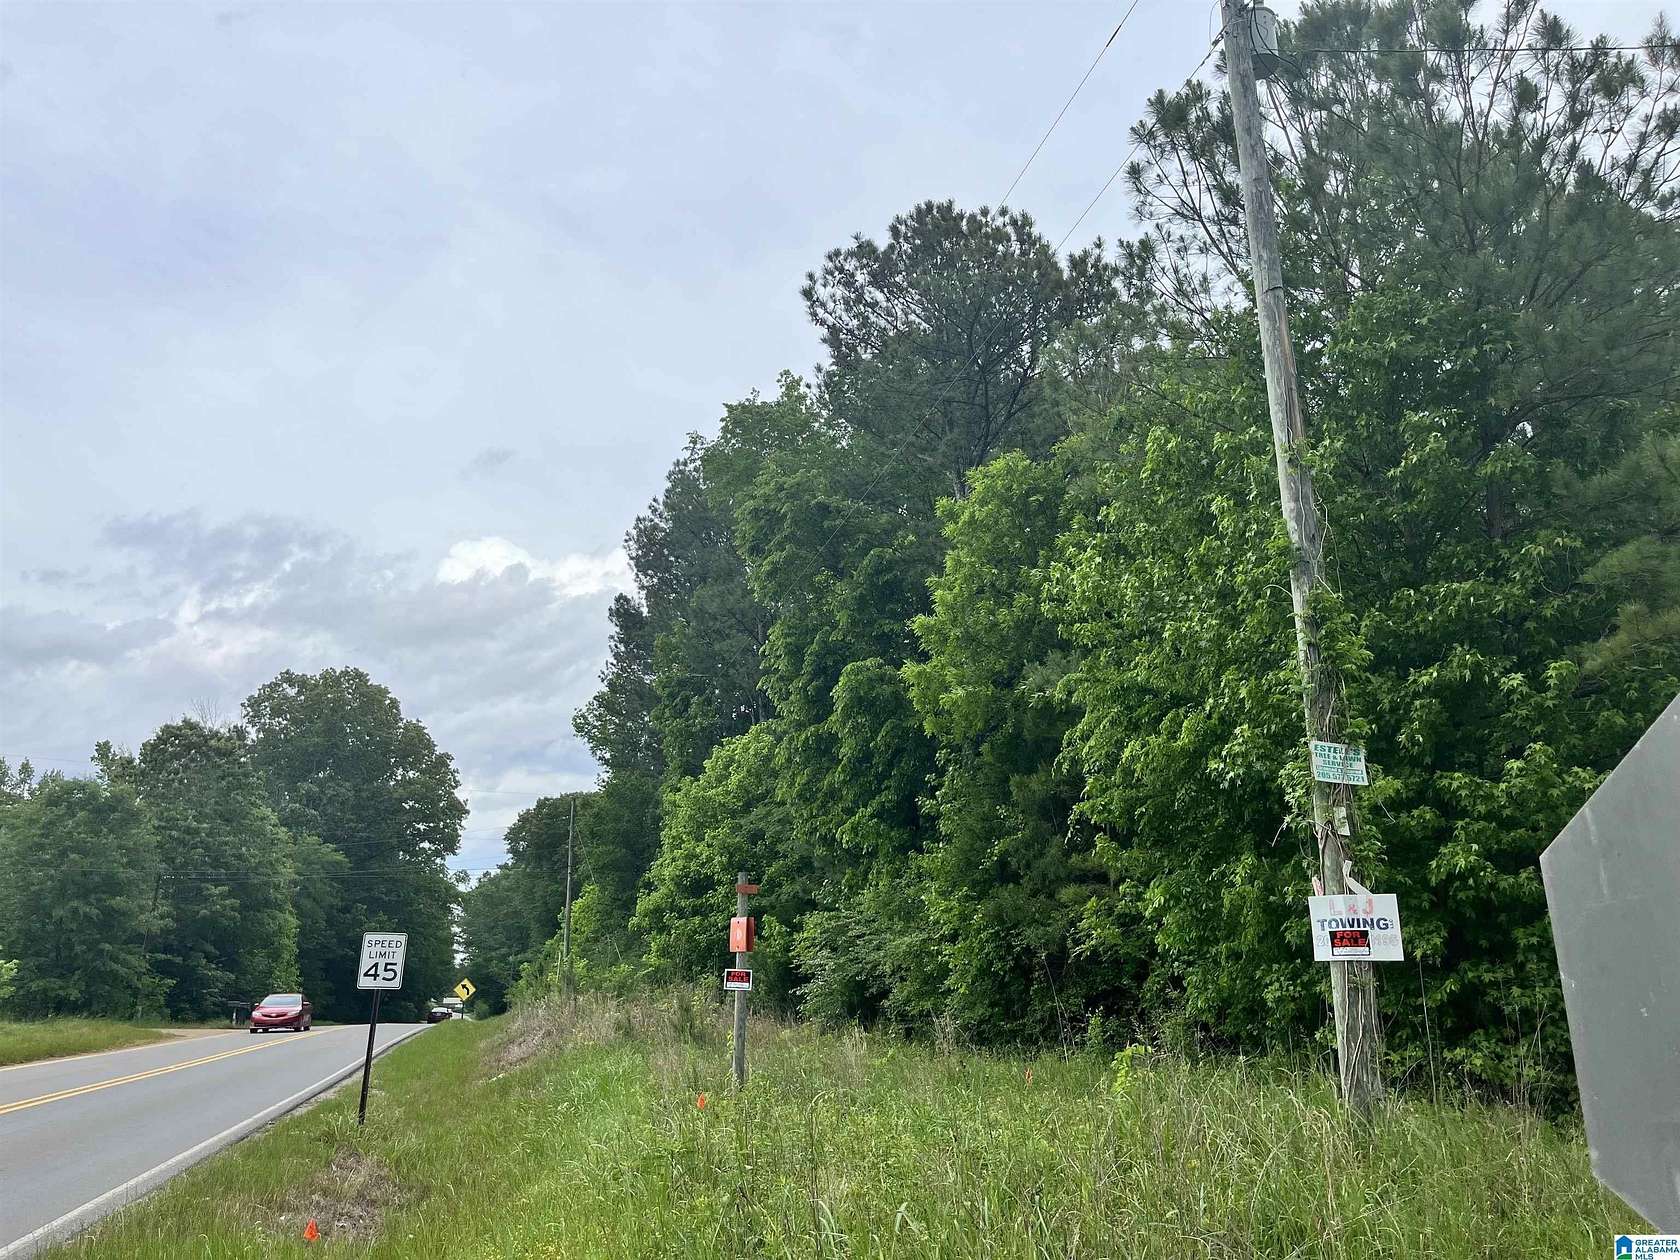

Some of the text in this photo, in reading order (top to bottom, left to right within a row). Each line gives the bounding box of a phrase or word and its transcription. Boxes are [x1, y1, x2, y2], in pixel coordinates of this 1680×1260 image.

[1328, 898, 1343, 916] L
[1362, 895, 1375, 916] J
[1316, 917, 1389, 931] TOWING
[1336, 931, 1360, 939] FOR
[367, 940, 403, 949] SPEED
[1334, 938, 1366, 947] SALE
[368, 951, 397, 960] LIMIT
[363, 962, 398, 981] 45
